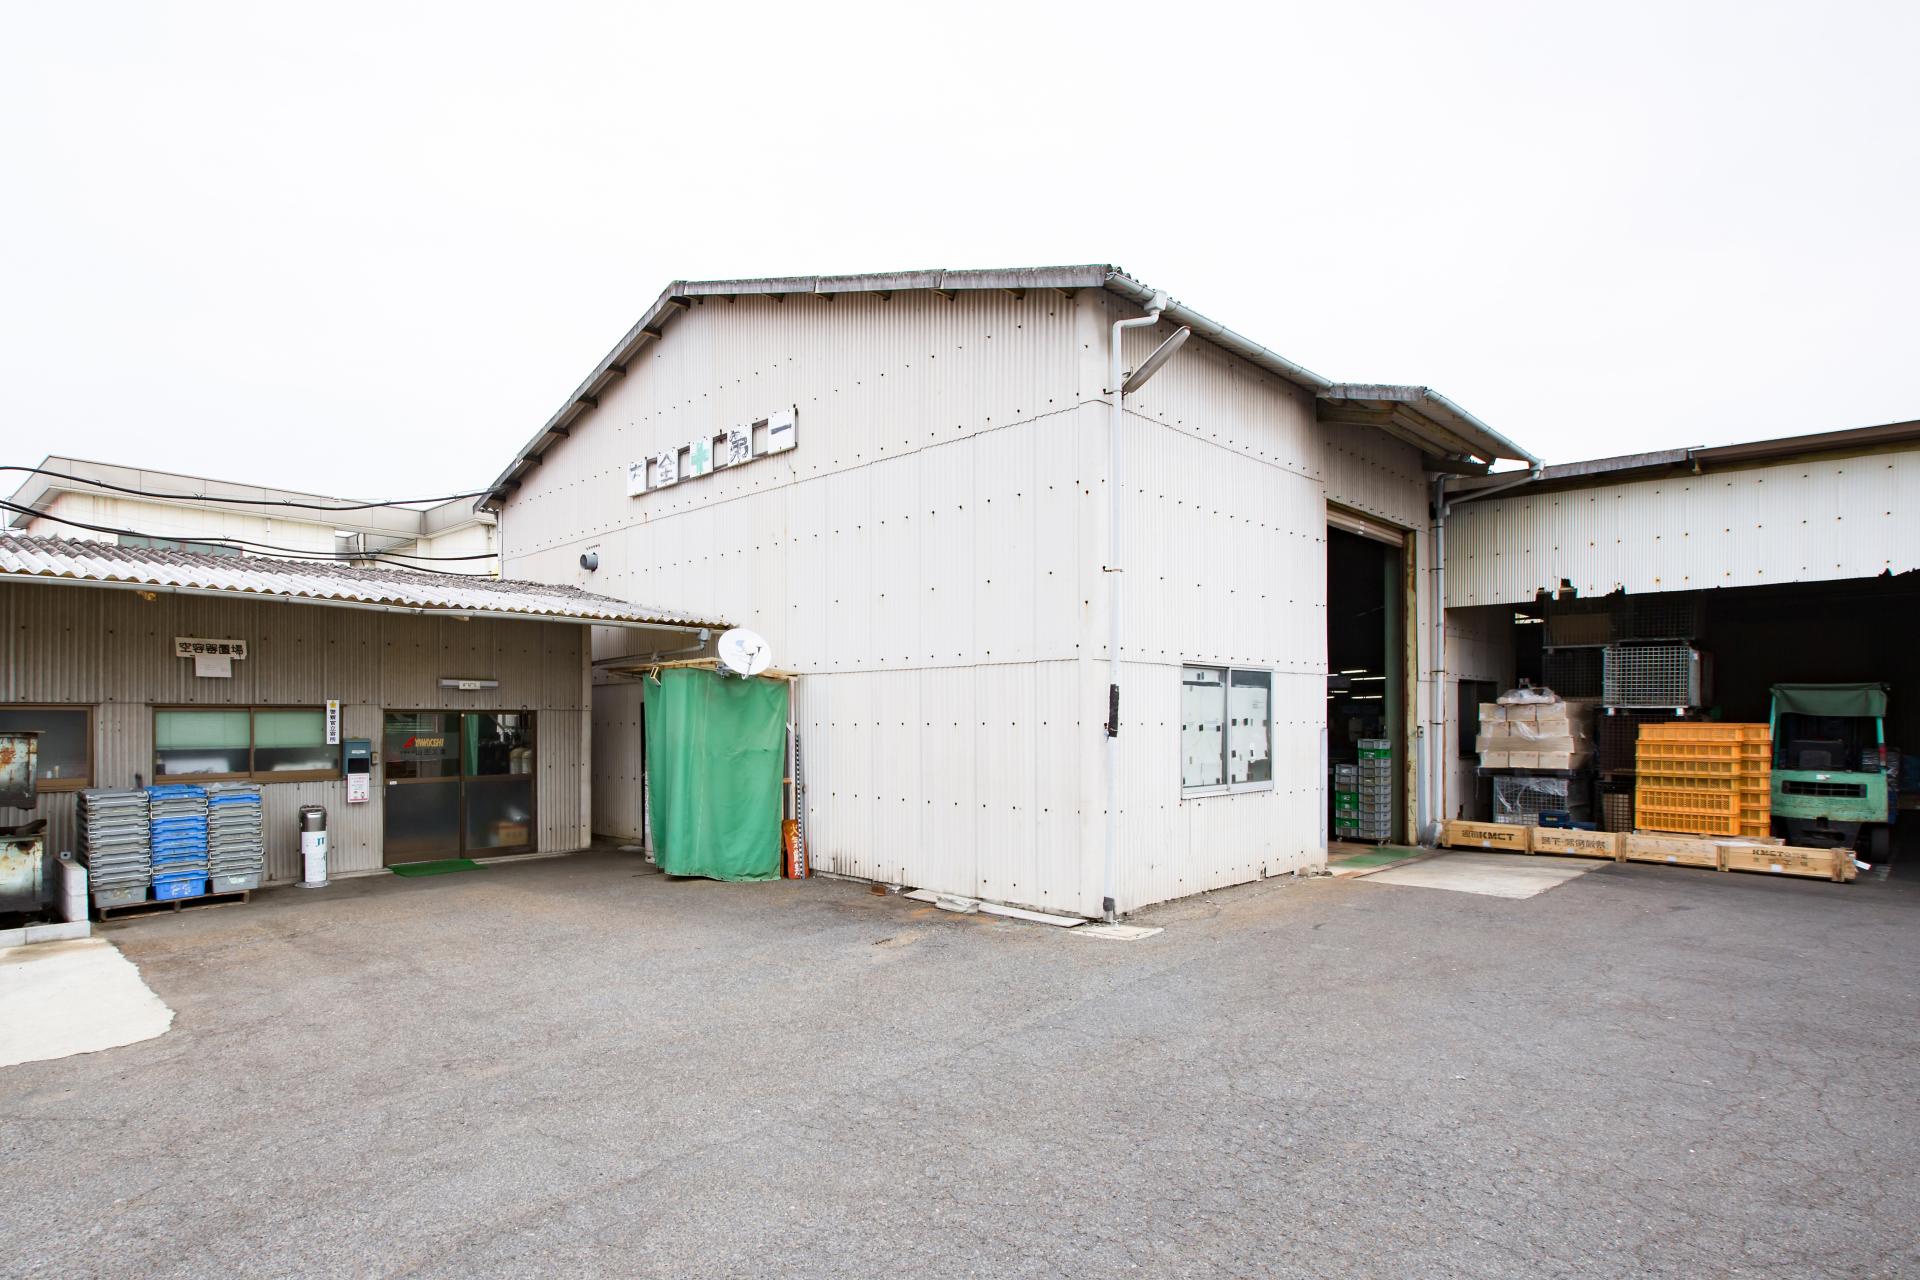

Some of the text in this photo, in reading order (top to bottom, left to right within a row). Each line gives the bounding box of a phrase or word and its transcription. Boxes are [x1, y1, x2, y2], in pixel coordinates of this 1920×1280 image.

[178, 642, 244, 655] 空容器置場
